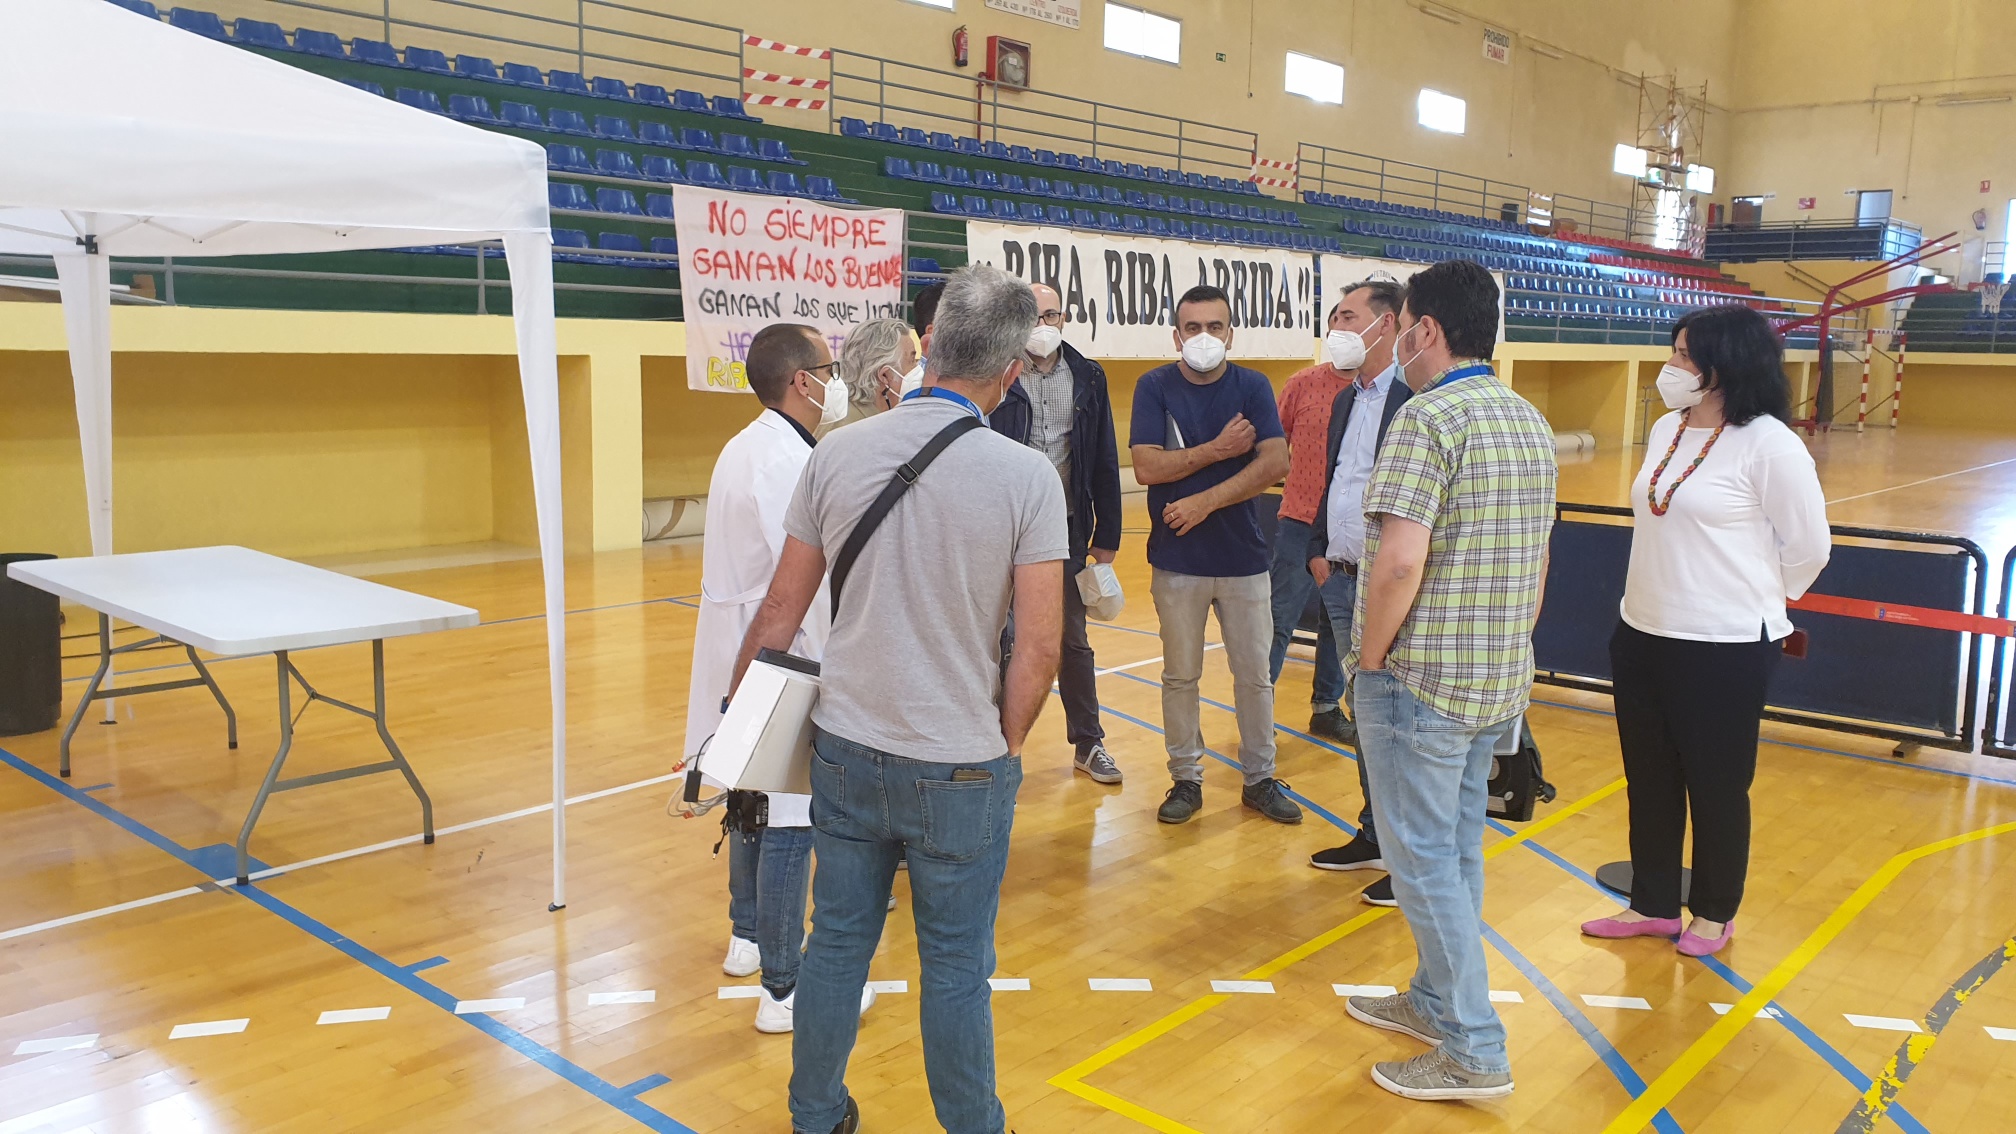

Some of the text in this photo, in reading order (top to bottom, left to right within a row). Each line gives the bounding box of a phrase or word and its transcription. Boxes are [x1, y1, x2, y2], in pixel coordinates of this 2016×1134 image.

[1483, 27, 1510, 48] PROHIBIDO
[1486, 43, 1505, 62] FUMAR
[708, 200, 747, 237] NO
[692, 246, 902, 290] GANAN LOS BUENOS
[698, 287, 781, 319] GANAN
[792, 292, 819, 319] LOS
[826, 301, 860, 326] QUE
[1104, 249, 1176, 327] RIBA
